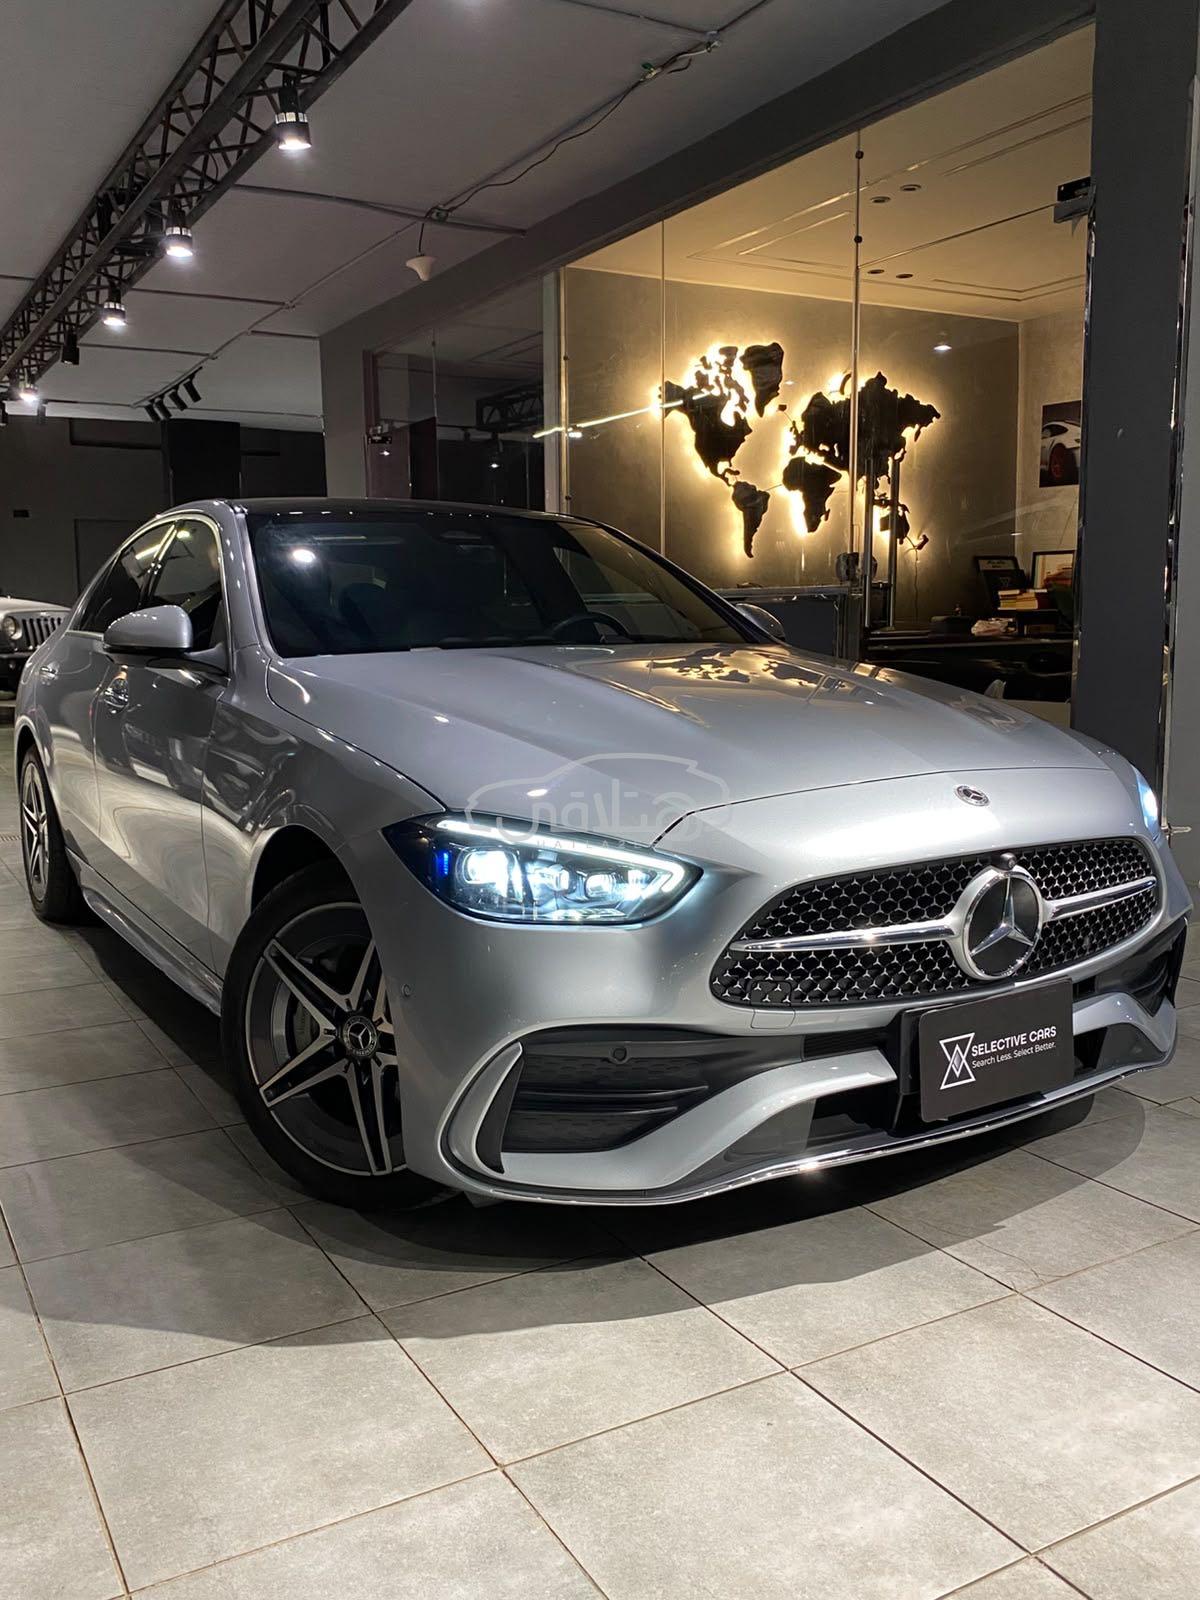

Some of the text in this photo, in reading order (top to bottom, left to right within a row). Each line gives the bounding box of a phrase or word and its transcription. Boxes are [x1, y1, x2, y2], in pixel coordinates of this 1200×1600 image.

[971, 1026, 1057, 1057] SELECTIVE CARS
[971, 1042, 1057, 1069] Search Less. Select Better.
